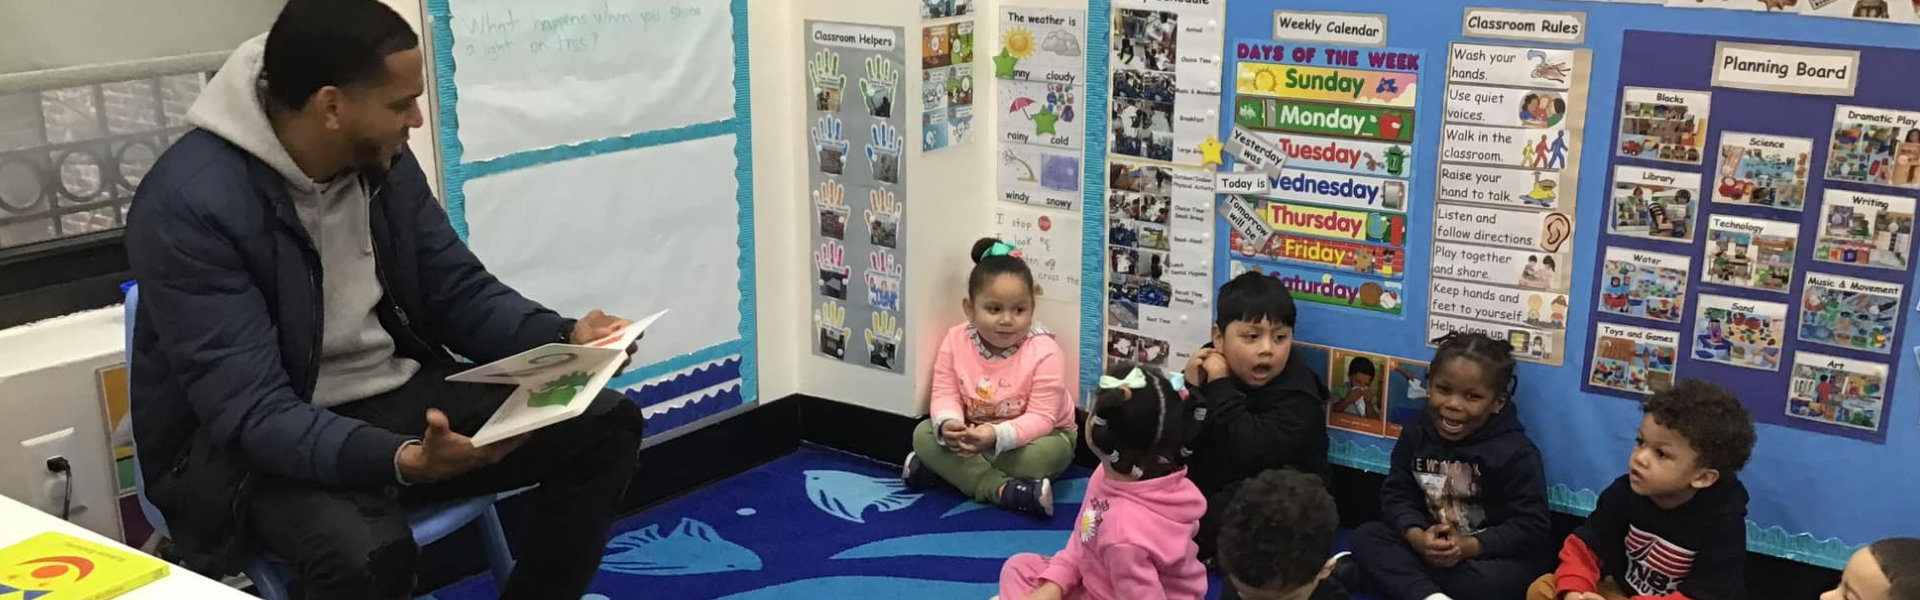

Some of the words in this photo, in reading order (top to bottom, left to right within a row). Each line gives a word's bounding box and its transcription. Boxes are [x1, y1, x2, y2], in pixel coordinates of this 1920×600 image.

[464, 10, 519, 35] What
[640, 10, 660, 28] you
[1008, 12, 1024, 23] The
[1028, 14, 1065, 26] weather
[1068, 16, 1076, 27] is
[1279, 16, 1323, 34] Weekly
[1326, 21, 1380, 38] Calendar
[1468, 16, 1536, 32] Classroom
[1541, 19, 1579, 35] Rules
[814, 30, 856, 44] Classroom
[859, 33, 892, 47] Helpers
[530, 42, 548, 55] on
[1454, 47, 1486, 62] Wash
[1489, 52, 1516, 65] your
[1237, 43, 1285, 62] DAYS
[1292, 47, 1316, 64] OF
[1325, 48, 1359, 67] THE
[1368, 51, 1420, 71] WEEK
[1451, 67, 1488, 81] hands.
[1723, 56, 1789, 79] Planning
[1796, 62, 1847, 80] Board
[1046, 70, 1075, 84] cloudy
[1285, 68, 1365, 98] Sunday
[1449, 89, 1471, 102] Use
[1474, 91, 1504, 105] quiet
[1656, 93, 1684, 104] Blocks
[1280, 105, 1366, 135] Monday
[1447, 108, 1485, 122] voices.
[1848, 110, 1893, 124] Dramatic
[1896, 115, 1918, 128] Play
[1007, 131, 1029, 144] rainy
[1050, 136, 1070, 146] cold
[1446, 129, 1474, 142] Walk
[1478, 130, 1488, 143] in
[1492, 132, 1512, 144] the
[1749, 137, 1785, 149] Science
[1234, 129, 1283, 166] Yesterday
[1279, 138, 1362, 169] Tuesday
[1444, 148, 1504, 162] classroom.
[1243, 149, 1263, 165] was
[1221, 177, 1253, 191] Today
[1257, 178, 1266, 189] is
[1441, 168, 1472, 181] Raise
[1475, 173, 1502, 185] your
[1642, 172, 1676, 185] Library
[1005, 191, 1030, 204] windy
[1046, 197, 1072, 208] snowy
[1441, 186, 1468, 198] hand
[1472, 190, 1484, 200] to
[1488, 191, 1513, 203] talk.
[1852, 195, 1889, 211] Writing
[996, 213, 1005, 225] I
[1012, 217, 1032, 231] stop
[1229, 194, 1269, 237] Tomorrow
[1270, 205, 1364, 239] Thursday
[1438, 208, 1473, 222] Listen
[1475, 213, 1497, 225] and
[1229, 212, 1246, 229] will
[1245, 226, 1257, 240] be
[1713, 218, 1764, 234] Technology
[1436, 226, 1471, 239] follow
[1474, 229, 1535, 246] directions.
[1284, 239, 1347, 268] Friday
[1434, 246, 1457, 258] Play
[1461, 250, 1512, 264] together
[1633, 254, 1662, 265] Water
[1433, 264, 1454, 275] and
[1433, 283, 1460, 297] Keep
[1463, 287, 1495, 301] hands
[1499, 293, 1520, 304] and
[1808, 276, 1835, 289] Music
[1839, 280, 1846, 289] &
[1851, 282, 1899, 295] Movement
[1432, 299, 1456, 312] feet
[1460, 304, 1472, 314] to
[1731, 302, 1755, 313] Sand
[1430, 319, 1455, 332] Help
[1604, 326, 1626, 337] Toys
[1628, 329, 1643, 339] and
[1645, 332, 1674, 343] Games
[1827, 359, 1845, 370] Art
[1415, 457, 1438, 472] EW
